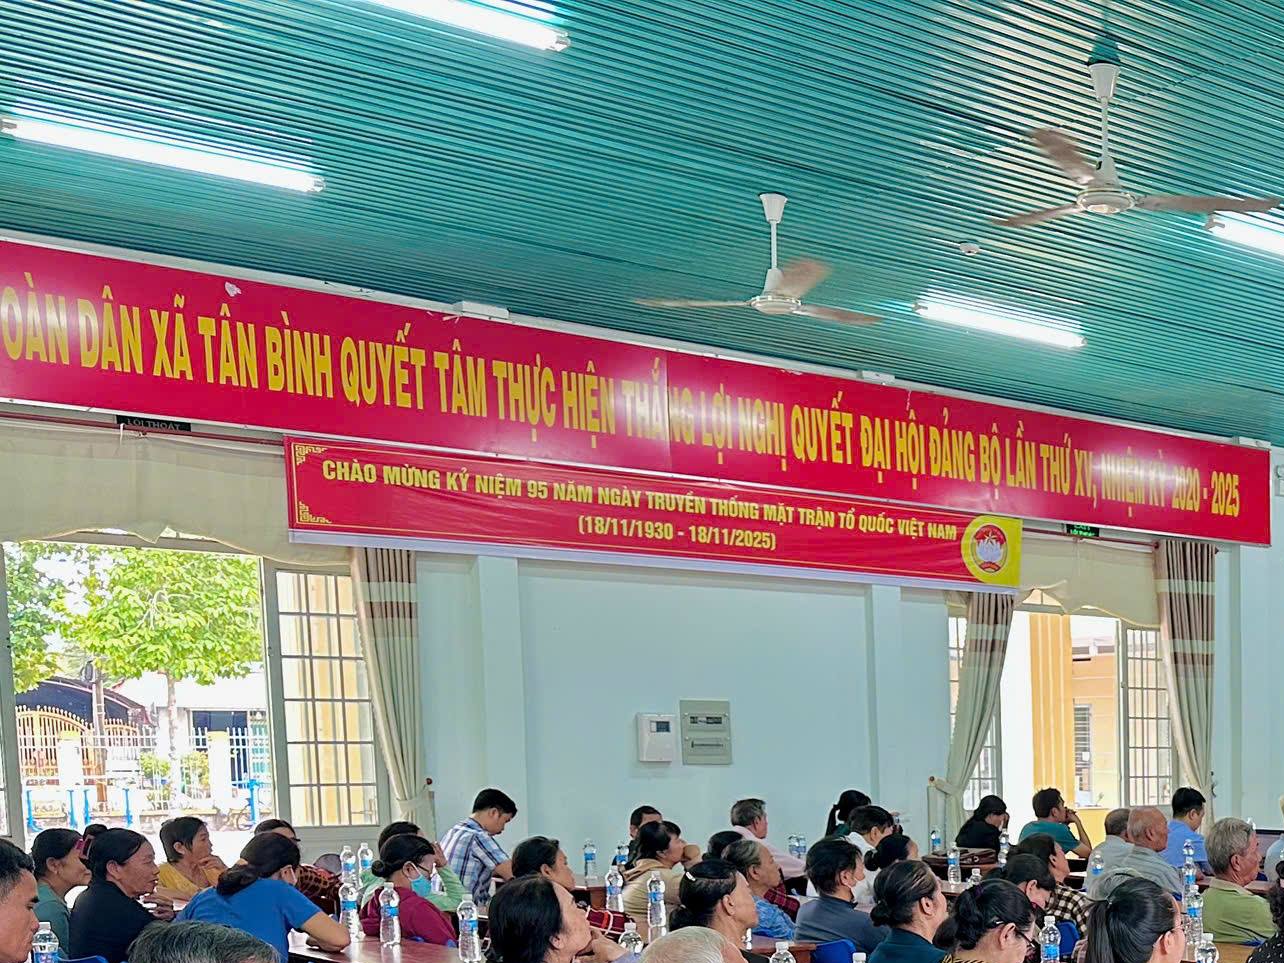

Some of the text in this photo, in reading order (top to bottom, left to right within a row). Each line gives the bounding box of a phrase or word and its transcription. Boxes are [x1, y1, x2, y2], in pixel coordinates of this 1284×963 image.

[1, 272, 70, 365] OÀN
[77, 285, 144, 374] DÂN
[150, 294, 193, 380] XÃ
[197, 303, 259, 388] TÂN
[265, 311, 334, 398] BÌNH
[341, 323, 426, 409] QUYẾT
[434, 338, 487, 417] TÂM
[492, 353, 556, 442] THỰC
[561, 360, 616, 448] HIỆN
[622, 357, 696, 444] THẮNG
[701, 383, 733, 464] LỢI
[738, 397, 787, 471] NGHỊ
[791, 391, 853, 464] QUYẾT
[860, 415, 891, 483] ĐẠI
[895, 409, 926, 490] HỘI
[929, 407, 976, 482] ĐẢNG
[979, 423, 1000, 500] BỘ
[1005, 420, 1036, 490] LẦN
[1040, 433, 1071, 495] THỨ
[1074, 449, 1097, 508] XV,
[1101, 446, 1145, 517] NHIỆM
[1149, 449, 1166, 507] KỲ
[1172, 465, 1200, 512] 2020
[1211, 471, 1240, 517] 2025
[322, 459, 957, 541] CHÀO MỪNG KỶ NIỆM 95 NĂM NGÀY TRUYỀN THỐNG MẶT TRẬN TỔ QUỐC VIỆT NAM
[578, 515, 673, 540] (18/11/1930
[689, 525, 776, 550] 18/11/2025)
